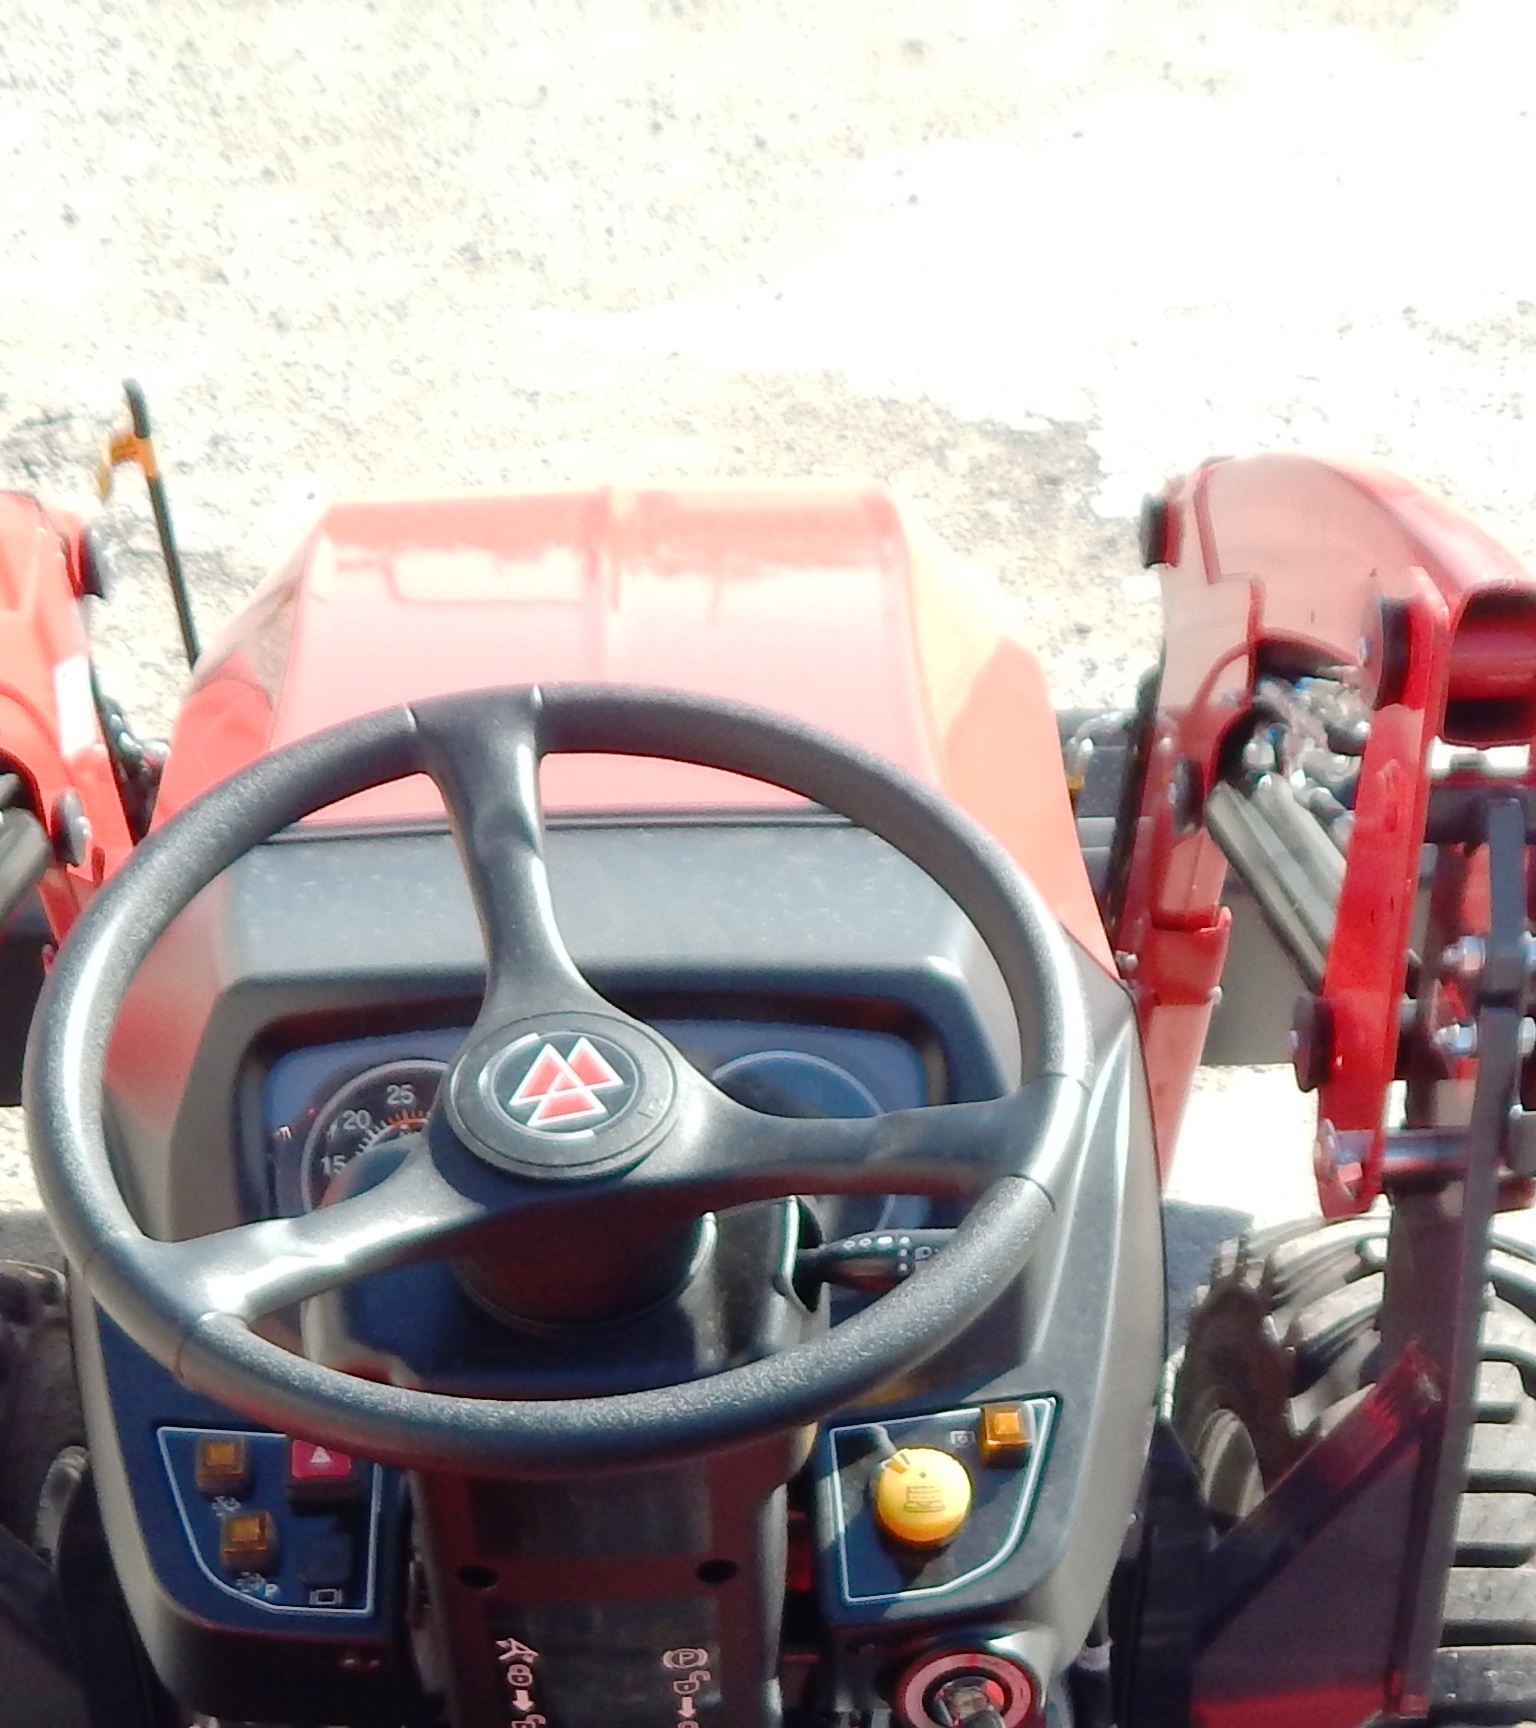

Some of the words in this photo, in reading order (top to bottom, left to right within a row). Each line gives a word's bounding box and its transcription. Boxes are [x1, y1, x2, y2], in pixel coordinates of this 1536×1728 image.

[385, 1084, 415, 1105] 25
[343, 1109, 372, 1130] 20
[320, 1154, 346, 1175] 15
